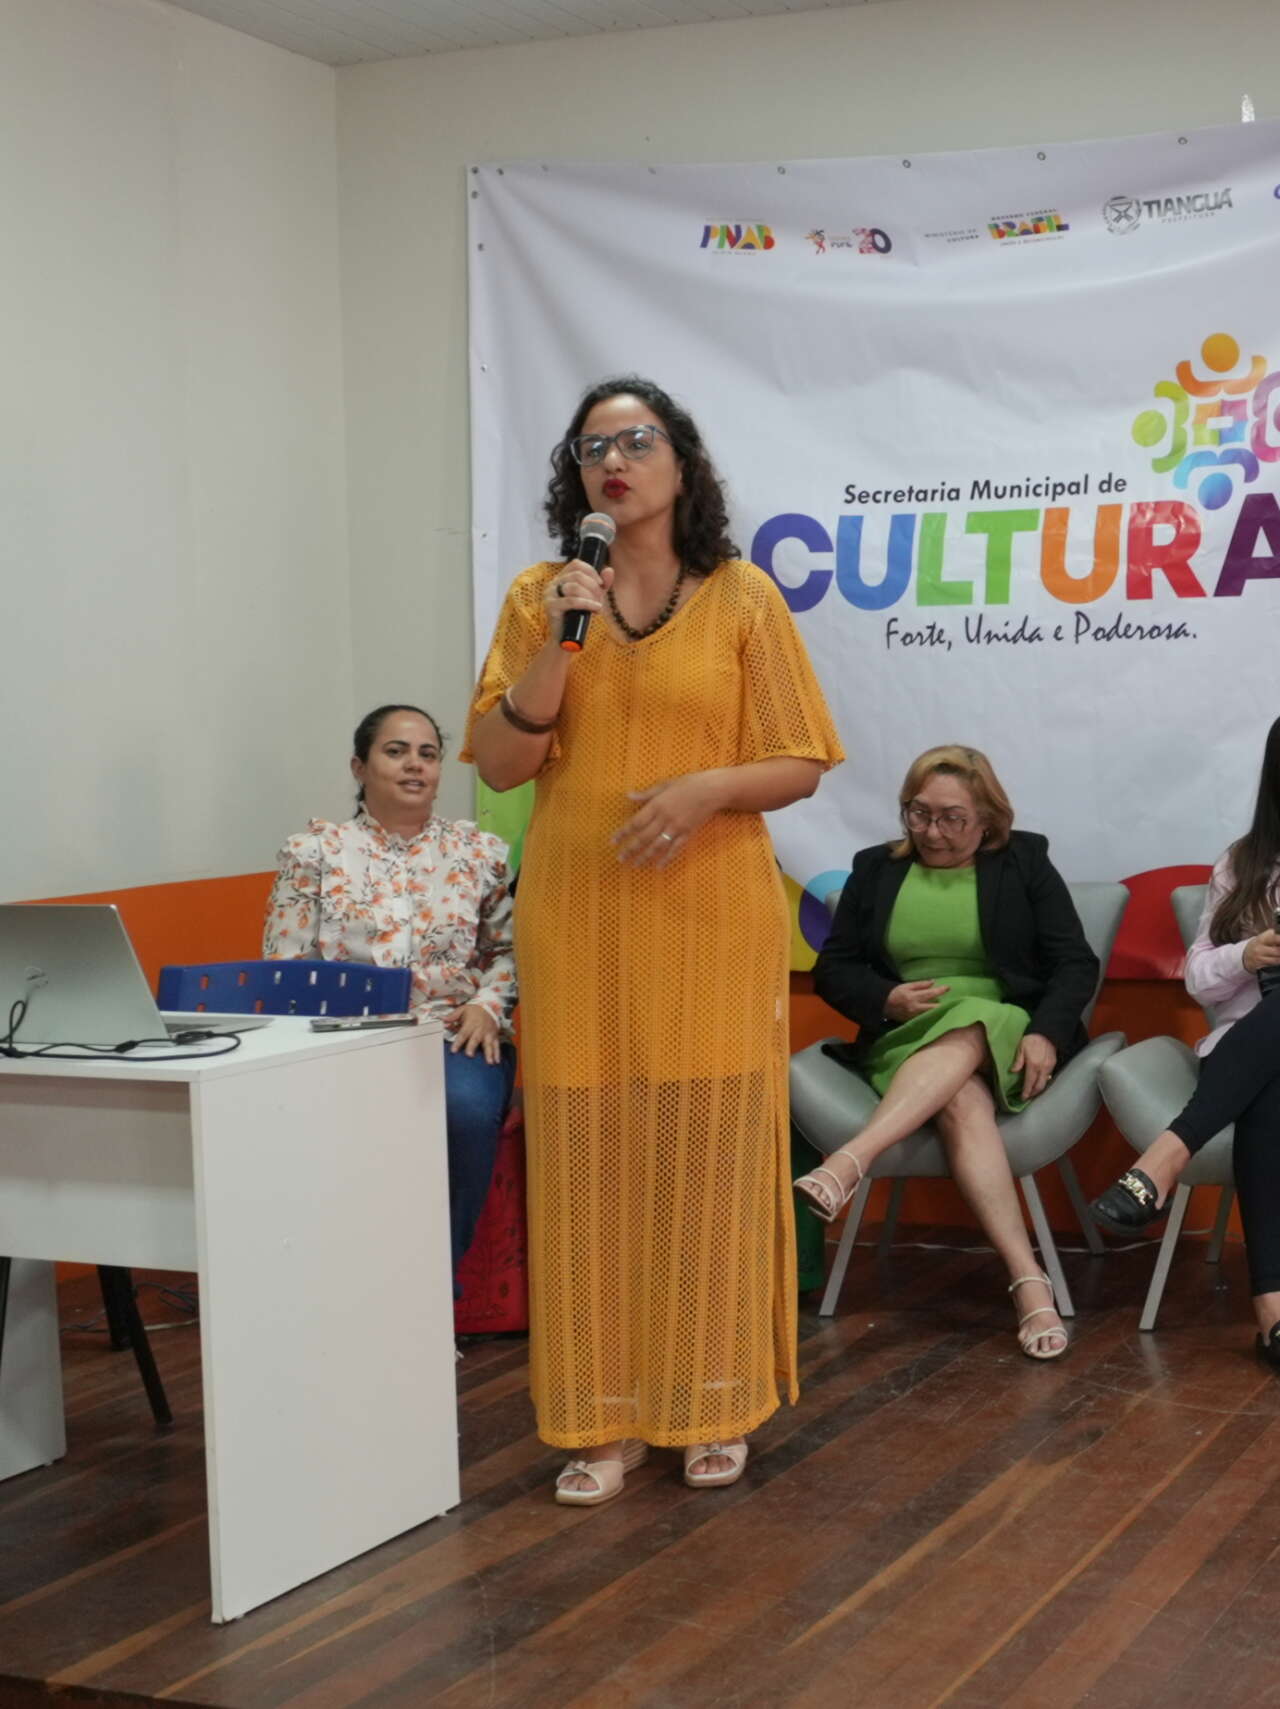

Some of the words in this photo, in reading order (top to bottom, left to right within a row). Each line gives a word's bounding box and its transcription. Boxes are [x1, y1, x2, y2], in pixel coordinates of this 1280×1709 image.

[1142, 187, 1233, 218] TIANGUÁ
[700, 224, 776, 251] PNAB
[843, 481, 961, 505] Secretaria
[970, 473, 1090, 501] Municipal
[1098, 472, 1128, 494] de
[886, 617, 953, 651] Forte,
[964, 612, 1045, 643] Unida
[1053, 624, 1065, 641] e
[1075, 610, 1197, 644] Poderosa.
